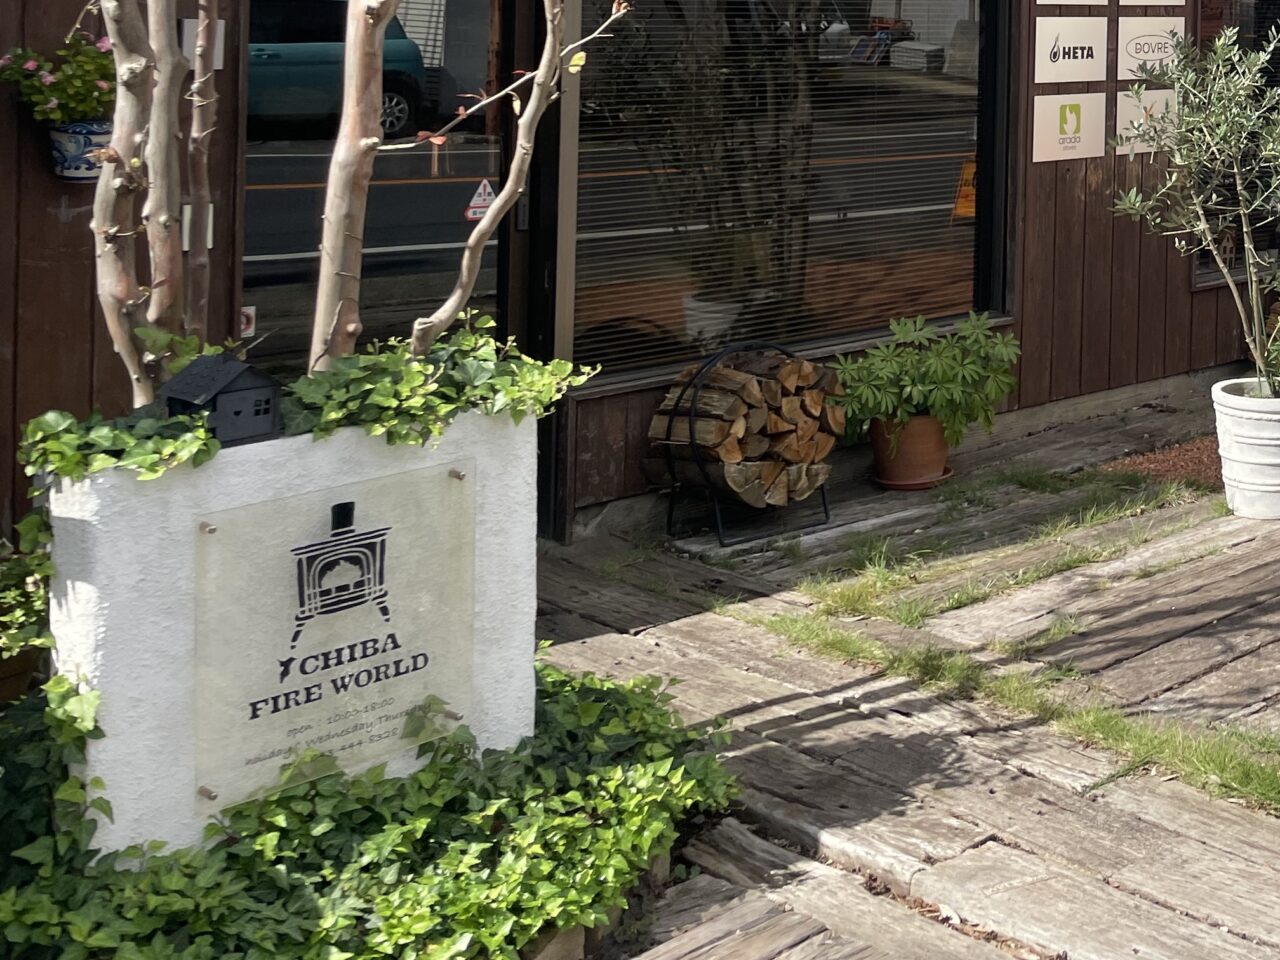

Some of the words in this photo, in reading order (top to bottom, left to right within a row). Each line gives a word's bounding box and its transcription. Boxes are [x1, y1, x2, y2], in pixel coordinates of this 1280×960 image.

[1062, 46, 1094, 60] HETA
[1058, 135, 1081, 145] arada
[248, 683, 323, 721] FIRE
[330, 652, 429, 695] WORLD
